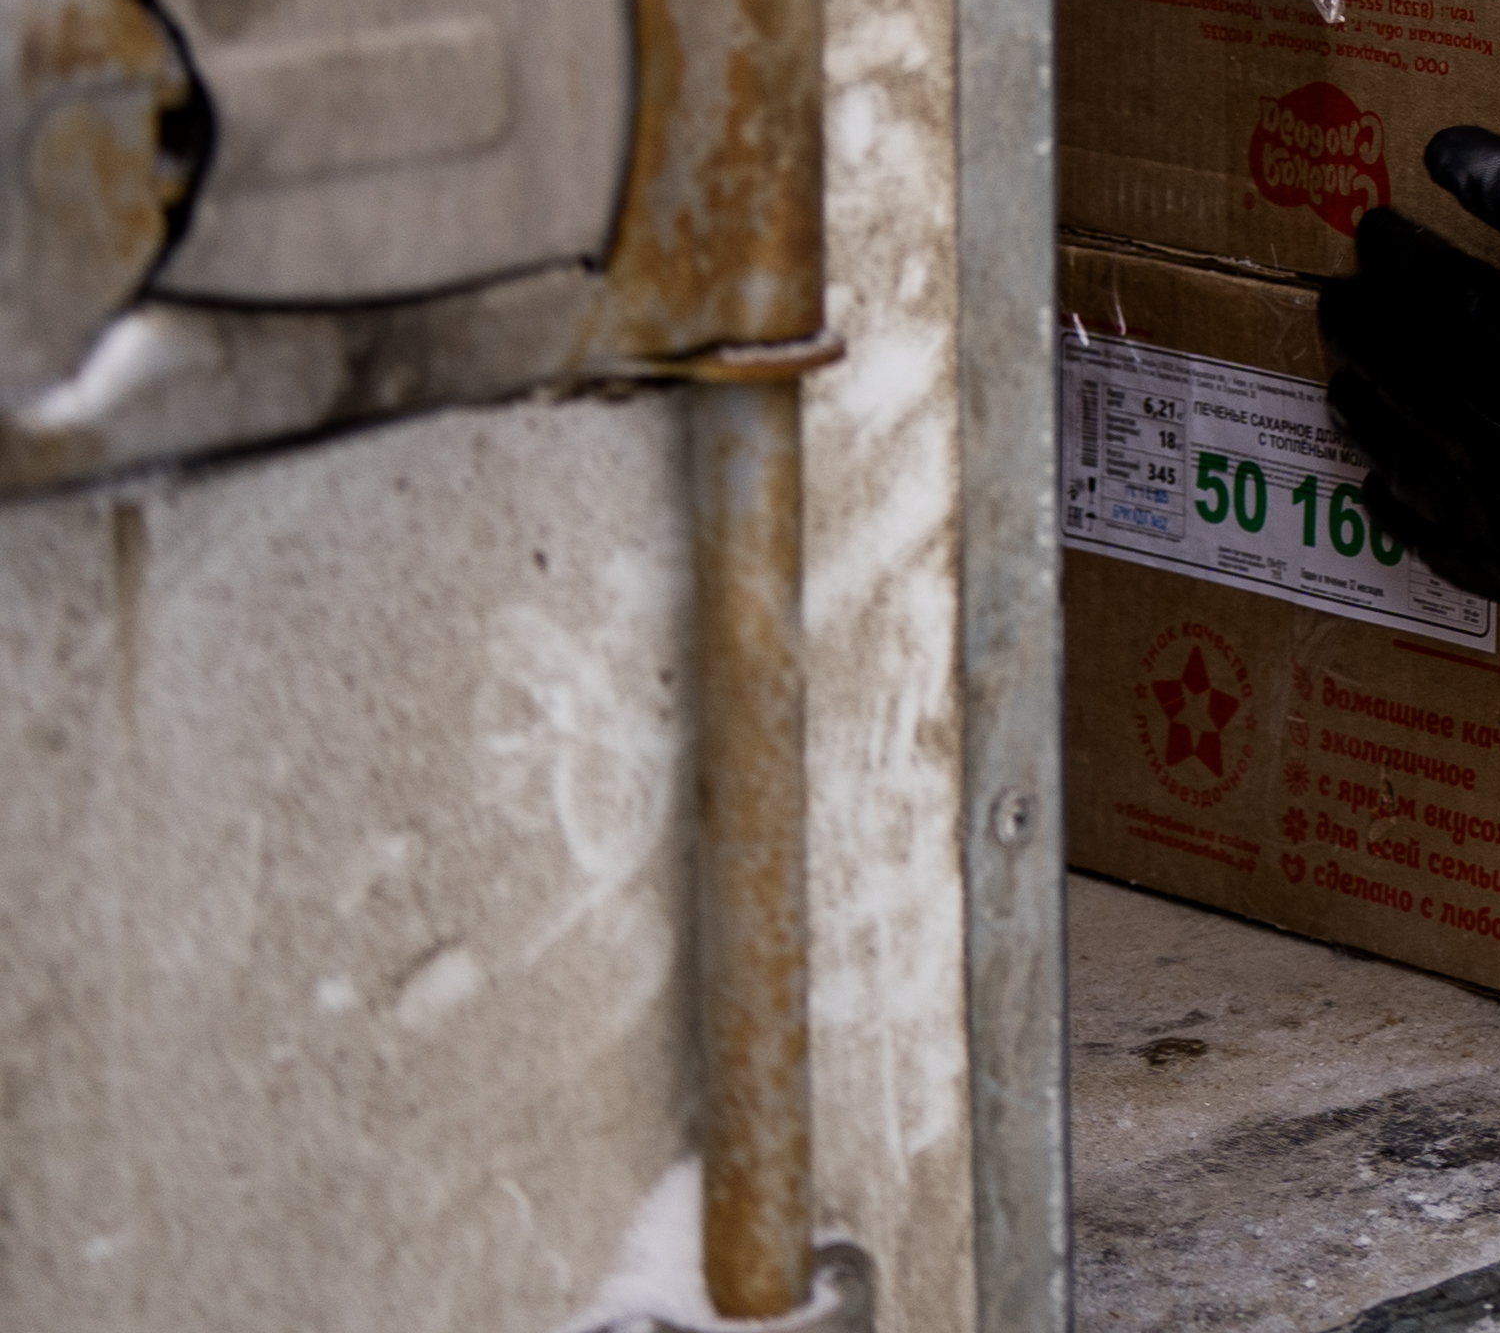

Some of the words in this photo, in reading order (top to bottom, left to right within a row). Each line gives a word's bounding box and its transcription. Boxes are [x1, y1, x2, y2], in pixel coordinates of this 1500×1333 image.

[1407, 27, 1493, 57] Кировская
[1413, 56, 1450, 76] ООО
[1262, 99, 1382, 165] Слобода
[1158, 430, 1176, 449] 18
[1193, 401, 1248, 425] ПЕЧЕНЬЕ
[1249, 413, 1313, 440] САХАРНОЕ
[1147, 462, 1176, 485] 345
[1195, 451, 1267, 533] 50
[1320, 675, 1455, 739] домашнее
[1319, 728, 1477, 792] экологичное
[1317, 773, 1332, 797] с
[1314, 810, 1359, 852] для
[1312, 859, 1414, 914] сделано
[1419, 895, 1434, 920] с
